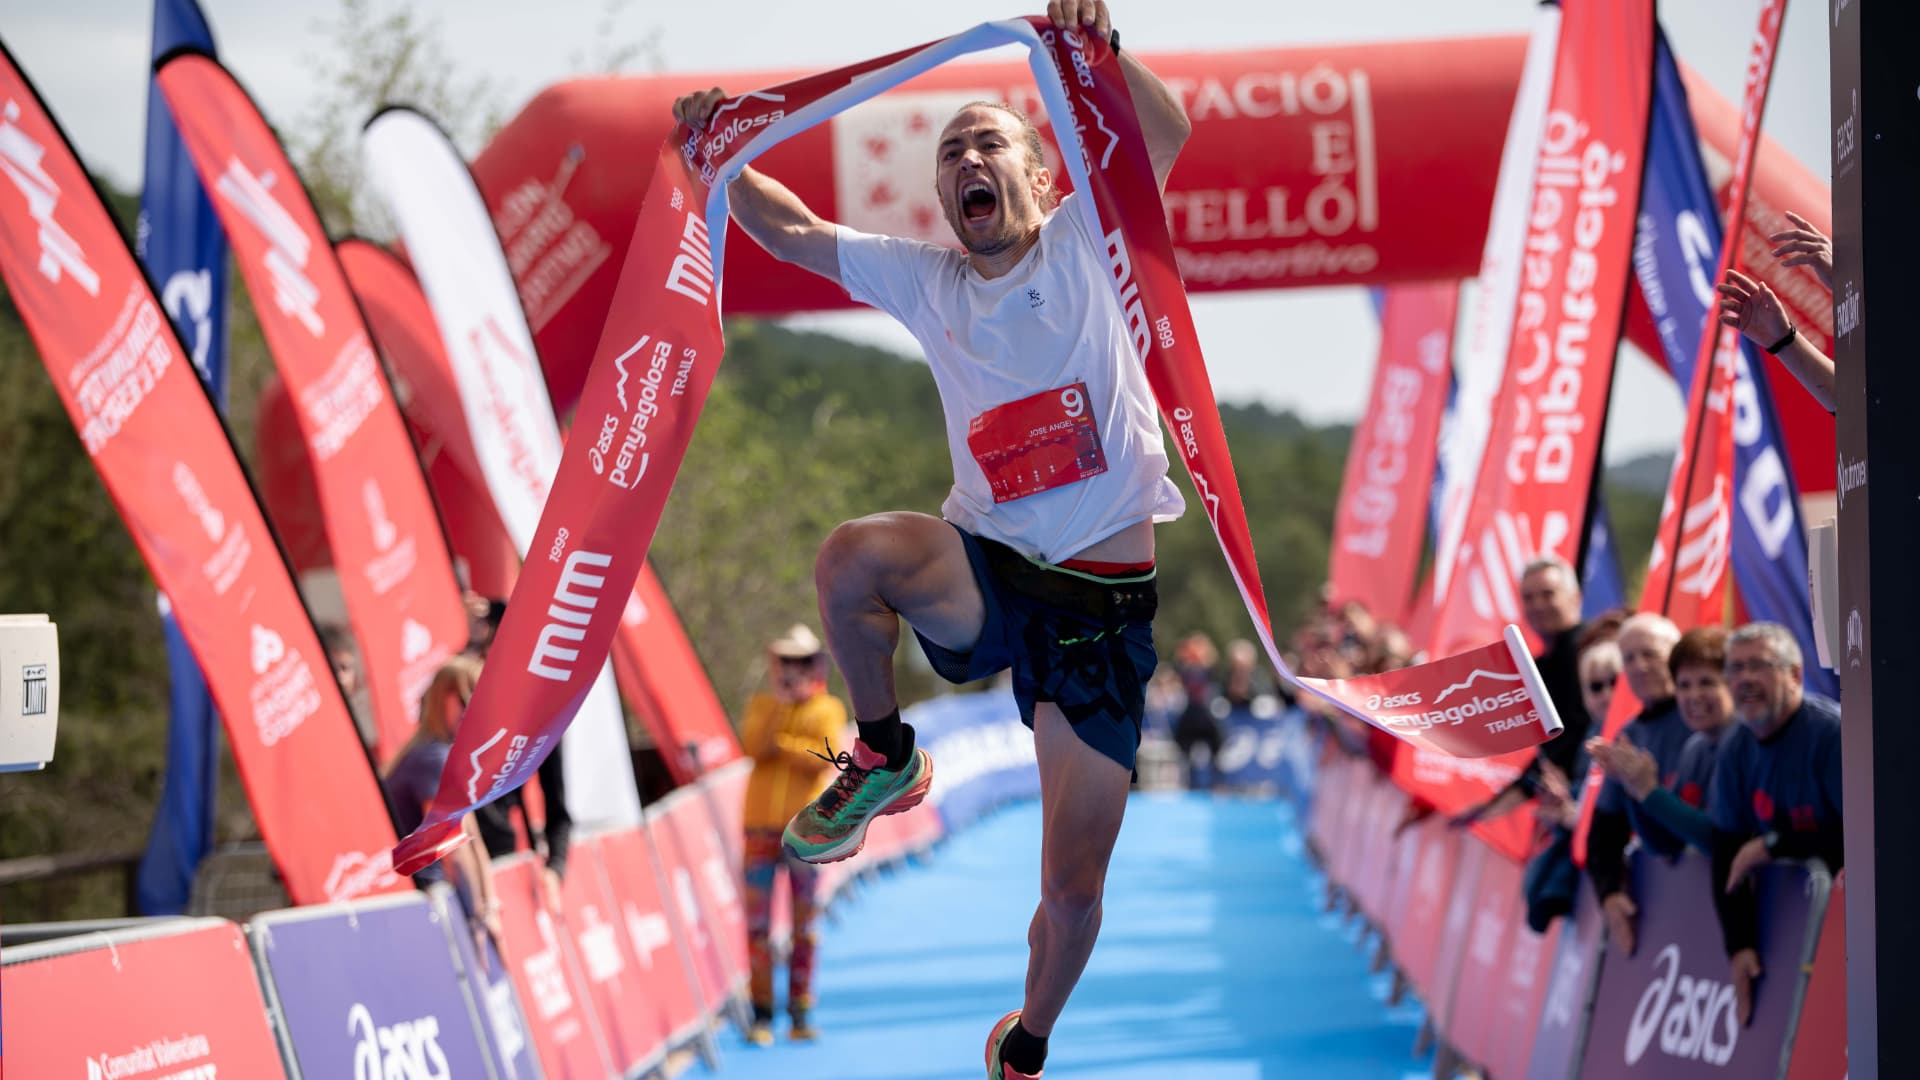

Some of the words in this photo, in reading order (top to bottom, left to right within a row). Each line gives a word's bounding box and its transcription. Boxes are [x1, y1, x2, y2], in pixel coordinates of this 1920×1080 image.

[1155, 314, 1175, 349] 1999
[670, 347, 697, 396] TRAILS
[608, 340, 673, 489] penyagolosa
[1061, 388, 1084, 418] 9
[596, 413, 619, 455] asics
[1029, 426, 1047, 438] JOSE
[1049, 420, 1075, 432] ANGEL
[1180, 421, 1199, 459] asics
[549, 527, 569, 563] 1999
[1375, 687, 1532, 730] penyagolosa
[1384, 691, 1422, 708] asics
[1484, 711, 1540, 735] TRAILS
[1660, 974, 1739, 1067] asics
